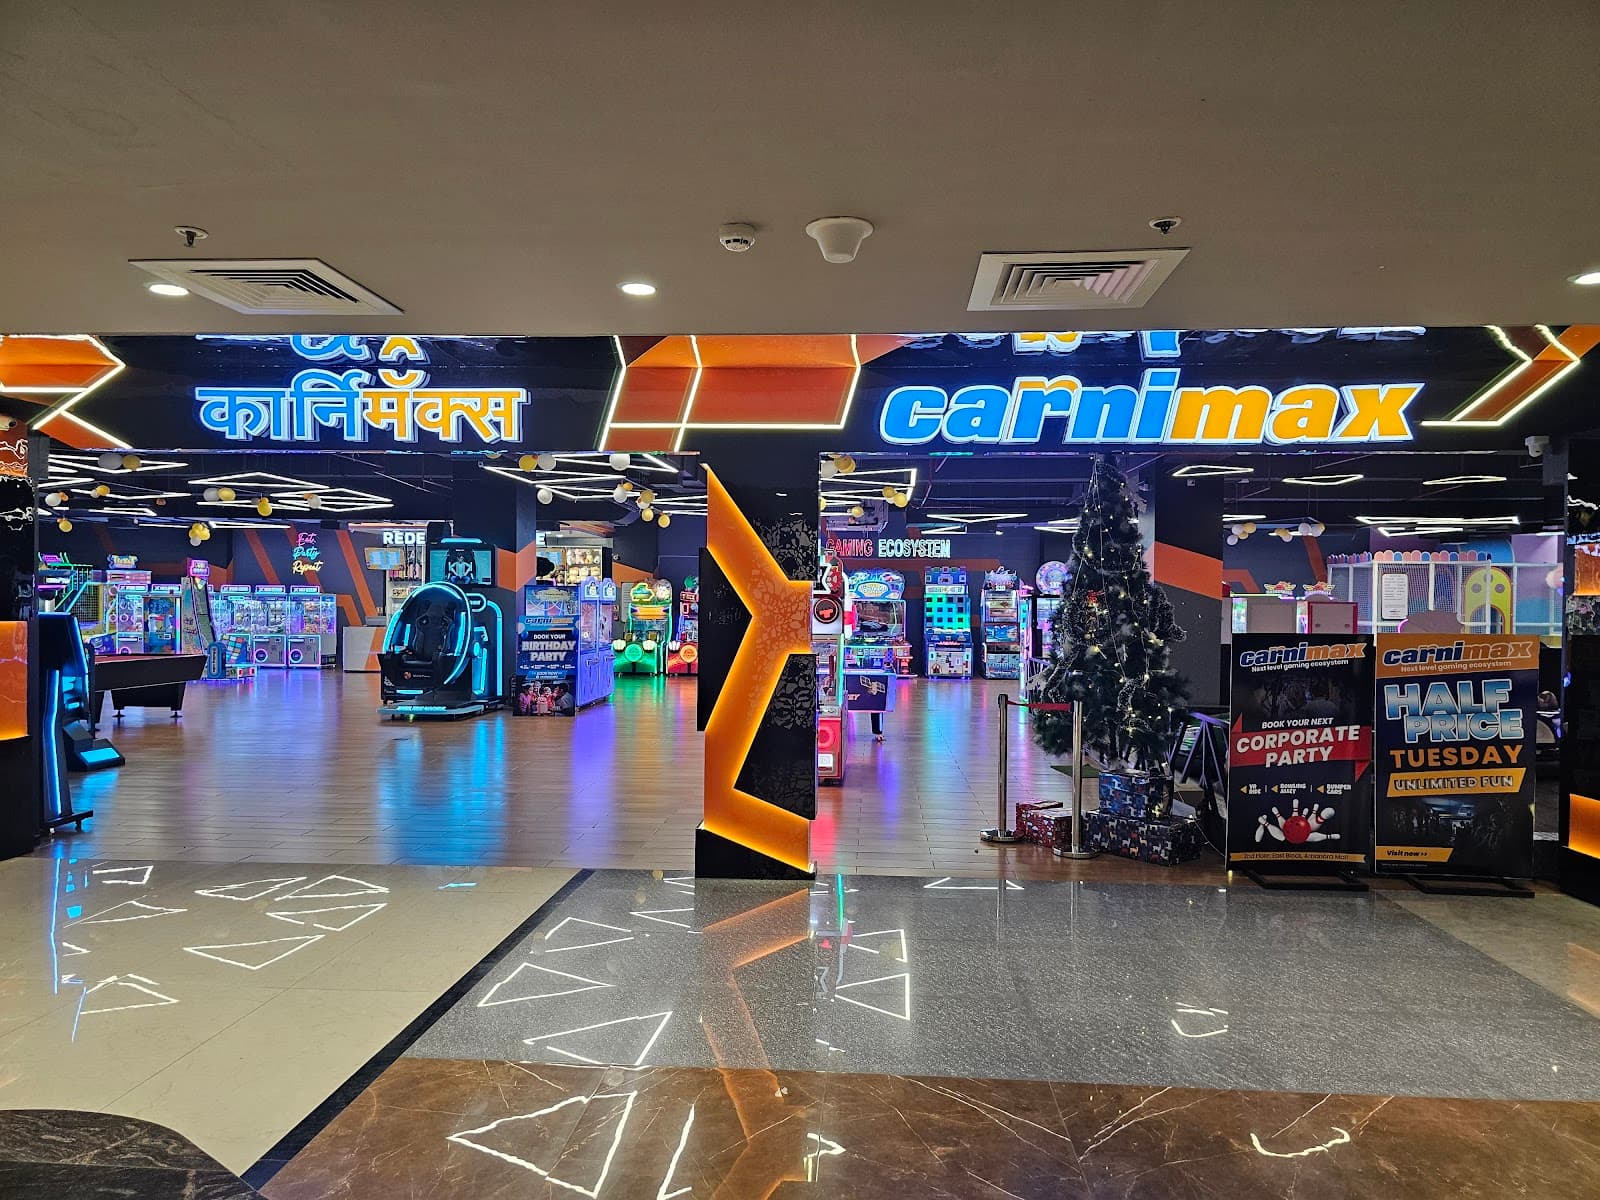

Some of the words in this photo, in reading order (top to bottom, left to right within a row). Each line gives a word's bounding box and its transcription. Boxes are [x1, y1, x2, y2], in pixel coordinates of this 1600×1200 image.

[879, 367, 1426, 444] carnimax
[826, 538, 873, 557] GAMING
[878, 539, 951, 558] ECOSYSTEM
[292, 560, 324, 575] Repeat
[521, 641, 576, 651] BIRTHDAY
[1240, 641, 1367, 667] carnimax
[1383, 640, 1533, 667] carnimax
[530, 652, 567, 662] PARTY
[1267, 663, 1283, 671] level
[1283, 661, 1310, 671] gaming
[1310, 659, 1349, 668] ecosystem
[1401, 665, 1419, 673] Next
[1419, 663, 1437, 671] level
[1437, 661, 1468, 671] gaming
[1469, 660, 1512, 669] ecosystem
[1384, 679, 1512, 720] HALF
[1261, 720, 1285, 729] BOOK
[1286, 718, 1310, 728] YOUR
[1310, 717, 1334, 726] NEXT
[1404, 708, 1524, 743] PRICE
[1236, 725, 1360, 753] CORPORATE
[1265, 746, 1334, 768] PARTY
[1390, 745, 1523, 769] TUESDAY
[1394, 777, 1478, 791] UNLIMITED
[1480, 775, 1514, 788] FUN
[1386, 849, 1404, 857] Visit
